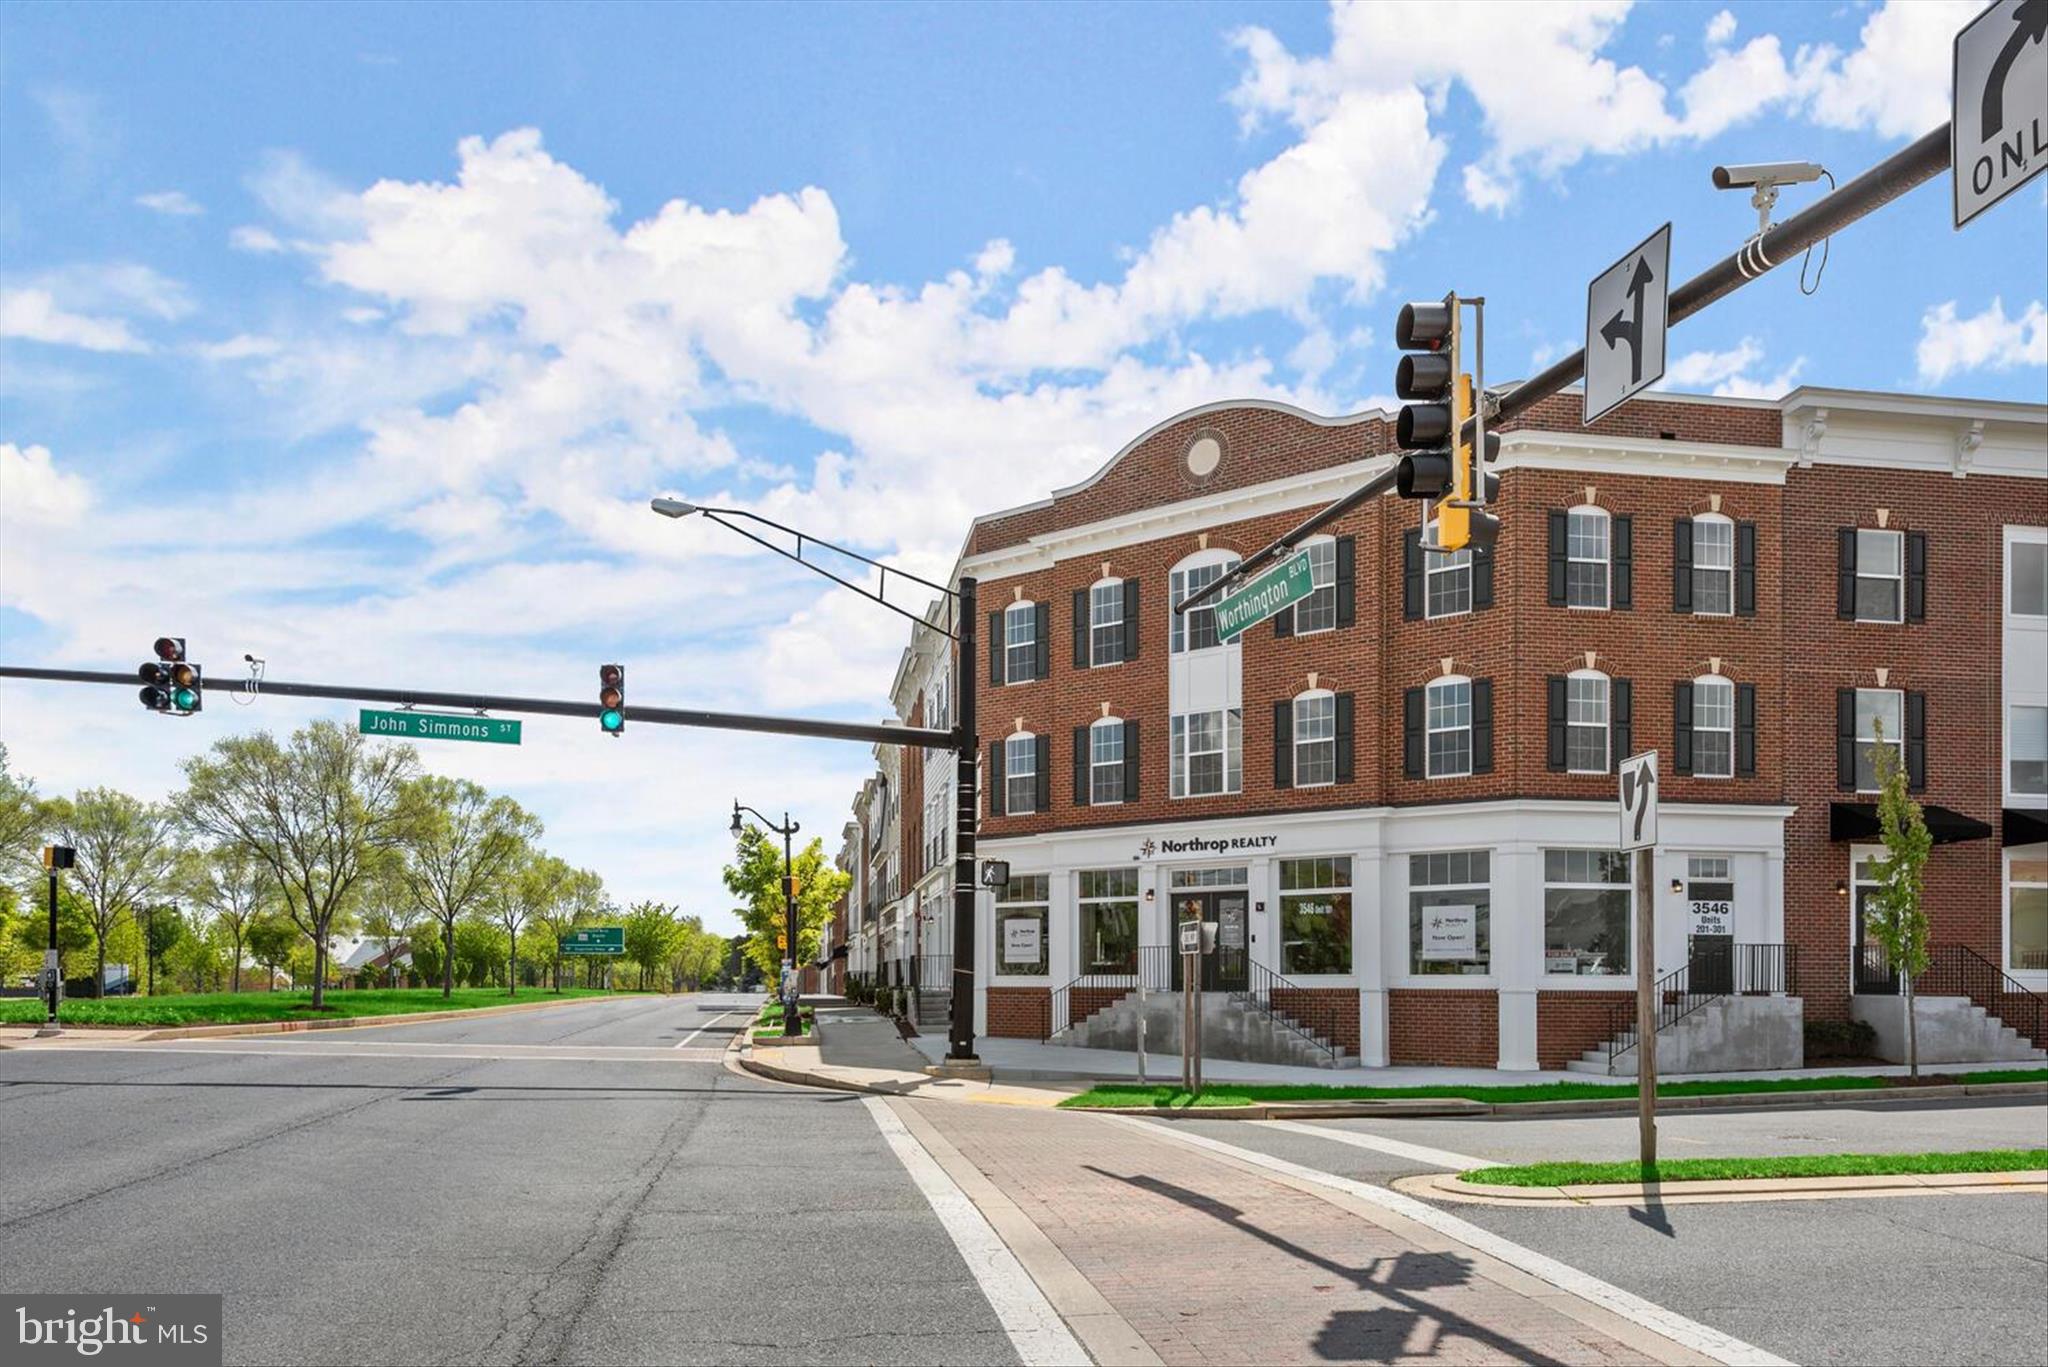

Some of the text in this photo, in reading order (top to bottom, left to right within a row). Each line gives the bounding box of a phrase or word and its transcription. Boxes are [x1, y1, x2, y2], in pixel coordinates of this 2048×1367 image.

[1219, 558, 1308, 632] Worthington BLVD
[370, 716, 511, 737] John Simmons ST
[1162, 836, 1277, 854] Northrop REALTY
[1692, 902, 1729, 915] 3546
[1701, 916, 1721, 924] Units
[1696, 925, 1726, 933] 201-301
